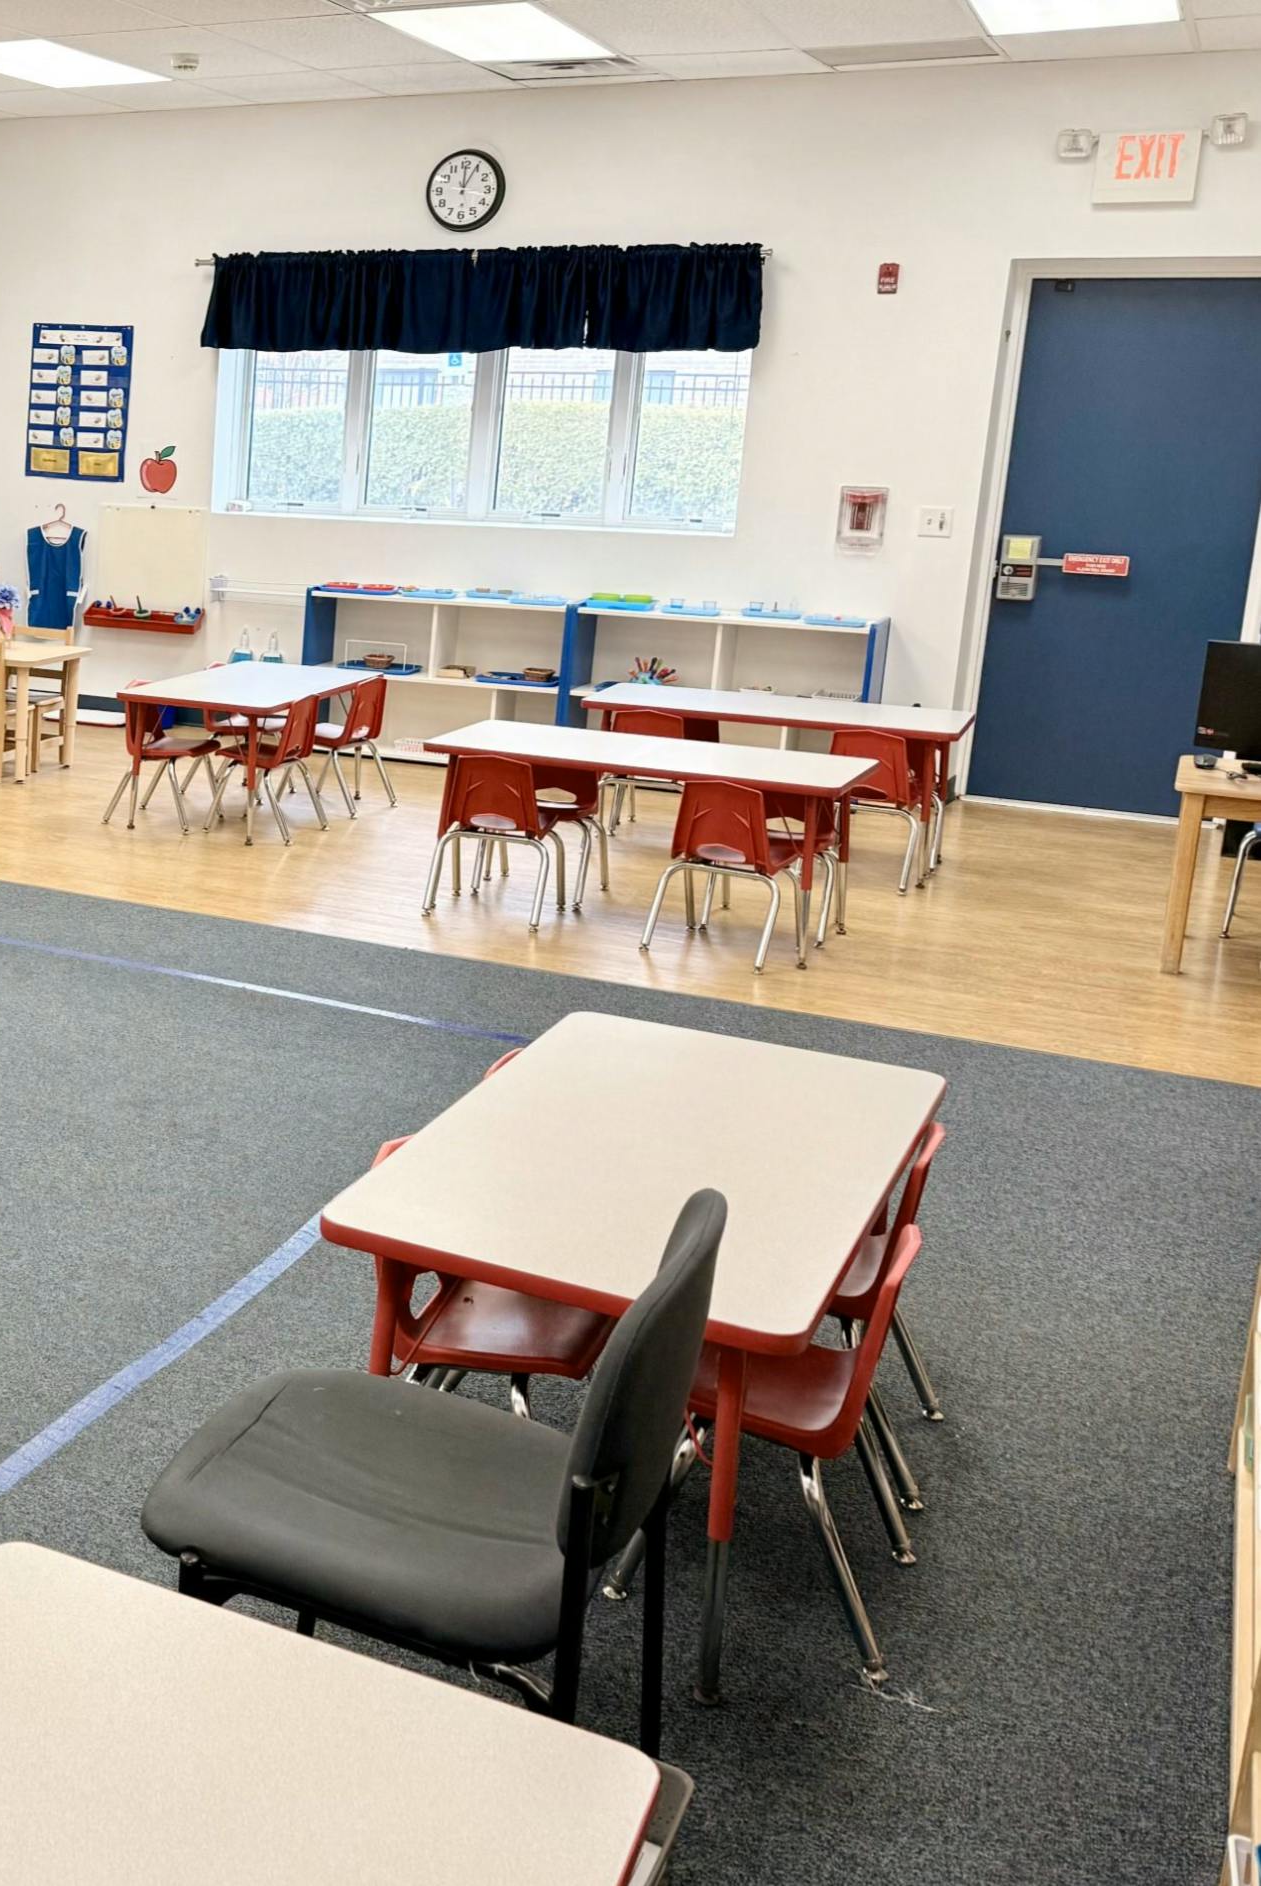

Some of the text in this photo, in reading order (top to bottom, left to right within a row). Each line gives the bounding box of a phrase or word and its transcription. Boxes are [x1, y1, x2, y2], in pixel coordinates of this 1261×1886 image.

[1115, 133, 1186, 180] EXIT
[450, 165, 458, 174] 11
[461, 160, 472, 170] 12
[481, 173, 489, 182] 2
[435, 187, 443, 196] 9
[484, 185, 492, 194] 3
[438, 199, 446, 208] 8
[478, 198, 486, 206] 4
[447, 208, 454, 216] 7
[457, 211, 465, 219] 6
[469, 207, 477, 216] 5
[1068, 555, 1097, 563] EMERGENCY
